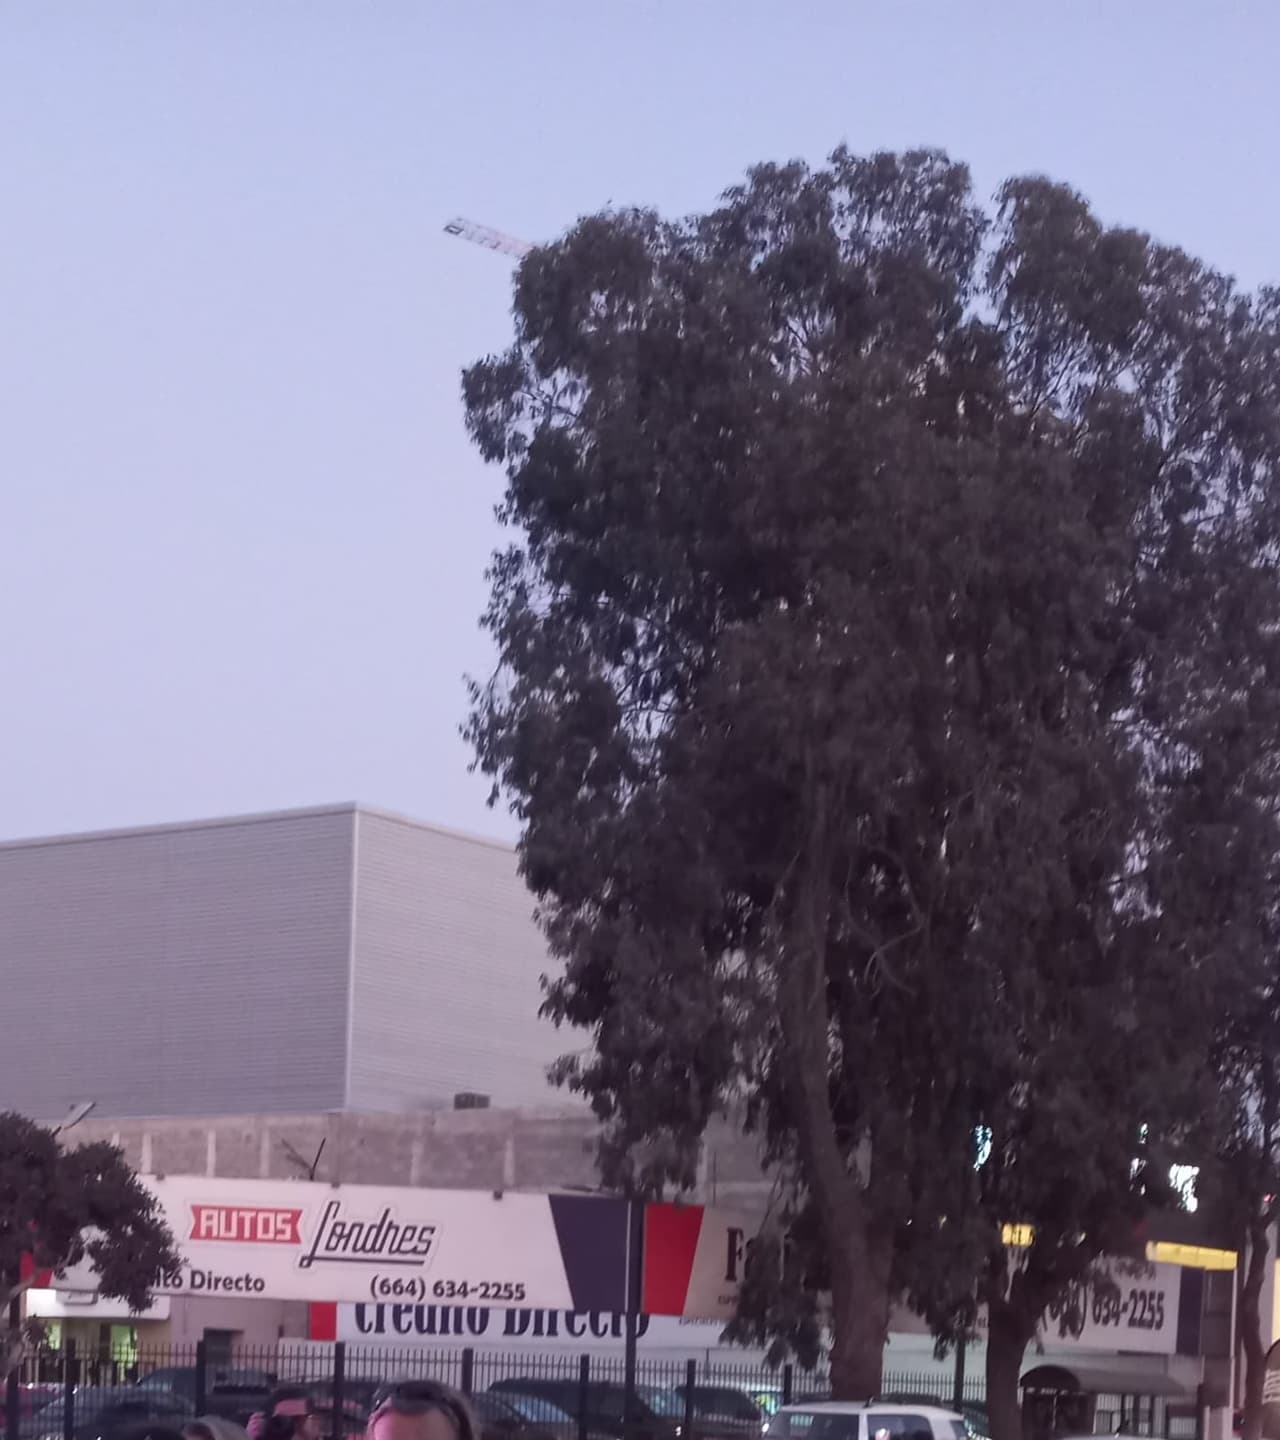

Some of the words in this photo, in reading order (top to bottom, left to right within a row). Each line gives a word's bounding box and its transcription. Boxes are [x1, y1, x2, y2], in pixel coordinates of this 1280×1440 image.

[199, 1208, 293, 1241] AUTOS
[298, 1200, 437, 1268] Londres
[189, 1269, 266, 1292] Directo
[369, 1273, 426, 1301] (664)
[431, 1279, 526, 1301] 634-2255
